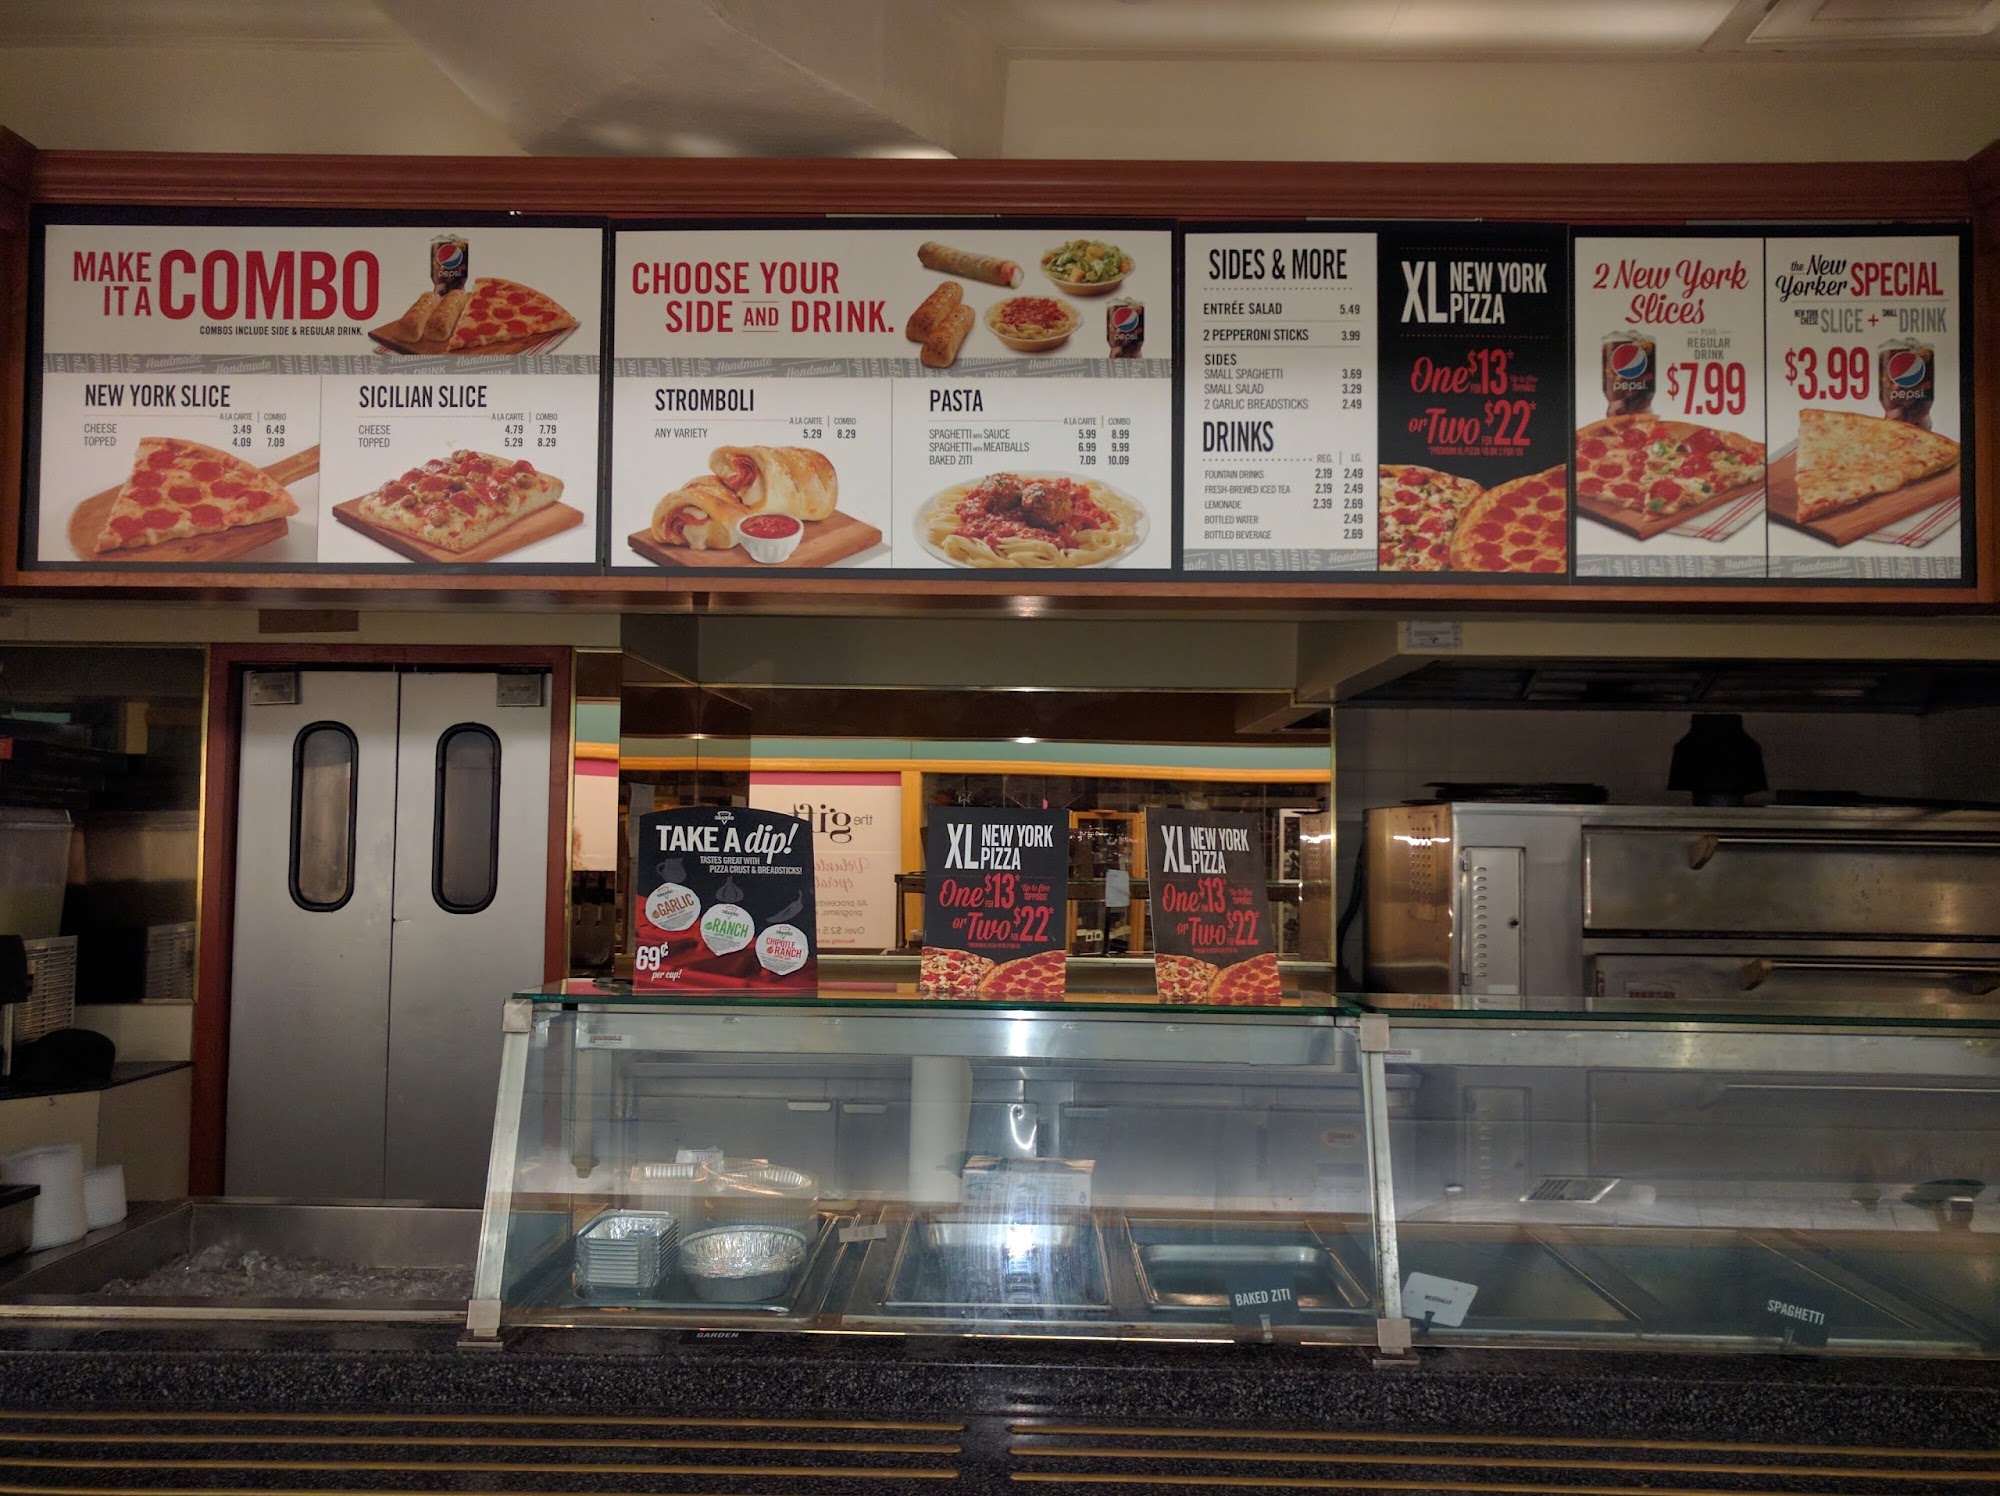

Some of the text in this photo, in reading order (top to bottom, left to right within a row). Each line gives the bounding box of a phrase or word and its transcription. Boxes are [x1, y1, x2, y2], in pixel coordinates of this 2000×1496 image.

[73, 251, 152, 282] MAKE
[1209, 249, 1347, 280] SIDES & MORE
[1790, 254, 1847, 275] the New
[159, 249, 379, 321] COMBO
[632, 262, 840, 295] CHOOSE YOUR
[1450, 261, 1548, 294] NEW YORK
[1592, 259, 1750, 299] 2 New York
[1775, 275, 1847, 303] Yorker
[1850, 261, 1944, 297] SPECIAL
[103, 286, 152, 316] IT A
[1400, 261, 1448, 324] XL
[665, 300, 894, 333] SIDE AND DRINK.
[1203, 300, 1360, 315] ENTRÉE SALAD 5.49
[1450, 293, 1505, 324] PIZZA
[1624, 292, 1705, 324] Slices
[200, 325, 364, 336] COMBOS INCLUDE SIDE & REGULAR DRINK.
[1820, 307, 1947, 333] SLICE DRINK
[1203, 329, 1360, 341] 2 PEPPERONI STICKS 3.99
[1687, 337, 1731, 348] REGULAR
[1204, 354, 1237, 366] SIDES
[1694, 349, 1725, 360] DRINK
[1204, 368, 1362, 380] SMALL SPAGHETTI 3.69
[1410, 356, 1471, 394] One
[1785, 346, 1870, 401] $3.99
[85, 384, 231, 408] NEW YORK SLICE
[359, 385, 487, 408] SICILIAN SLICE
[1204, 383, 1362, 395] SMALL SALAD 3.29
[1613, 380, 1647, 392] pepsi
[1666, 362, 1746, 415] $7.99
[1890, 389, 1924, 401] pepsi
[655, 388, 754, 411] STROMBOLI
[929, 389, 984, 412] PASTA
[1204, 399, 1362, 410] 2 GARLIC BREADSTICKS 2.49
[84, 423, 285, 435] CHEESE 3.49 6.49
[358, 424, 557, 435] CHEESE 4.79 7.79
[654, 428, 856, 439] ANY VARIETY 5.29 8.29
[929, 429, 1130, 440] SPAGHETTI SAUCE 5.99 8.99
[1203, 421, 1274, 452] DRINKS
[1408, 417, 1428, 433] or
[1425, 407, 1481, 445] Two
[84, 437, 285, 447] TOPPED 4.09 7.09
[358, 437, 557, 448] TOPPED 5.29 8.29
[929, 442, 1130, 452] SPAGHETTI MEATBALLS 6.99 9.99
[929, 455, 1130, 465] BAKED ZITI 7.09 10.09
[1205, 468, 1363, 479] FOUNTAIN DRINKS 2.19 2.49
[1205, 483, 1363, 494] FRESH-BREWED ICED TEA 2.19 2.49
[1205, 498, 1363, 509] LEMONADE 2.39 2.69
[655, 822, 799, 865] TAKE A dip!
[944, 823, 979, 869] XL
[981, 824, 1054, 848] NEW YORK
[1189, 826, 1250, 852] NEW YORK
[700, 856, 760, 865] TASTES GREAT WITH
[980, 847, 1021, 870] PIZZA
[1161, 825, 1192, 874] XL
[709, 865, 803, 875] PIZZA CRUST & BREADSTICKS!
[1191, 850, 1227, 875] PIZZA
[939, 878, 984, 908] One
[1162, 883, 1200, 912] One
[657, 894, 695, 917] GARLIC
[711, 918, 749, 938] RANCH
[952, 917, 968, 929] or
[967, 911, 1011, 941] Two
[1176, 922, 1189, 935] or
[1187, 916, 1227, 946] Two
[765, 937, 796, 948] CHIPOTLE
[774, 946, 802, 959] RANCH
[635, 941, 670, 971] 69¢
[651, 969, 683, 982] per cup!
[1234, 1288, 1291, 1307] BAKED ZITI
[1767, 1299, 1825, 1326] SPAGHETTI
